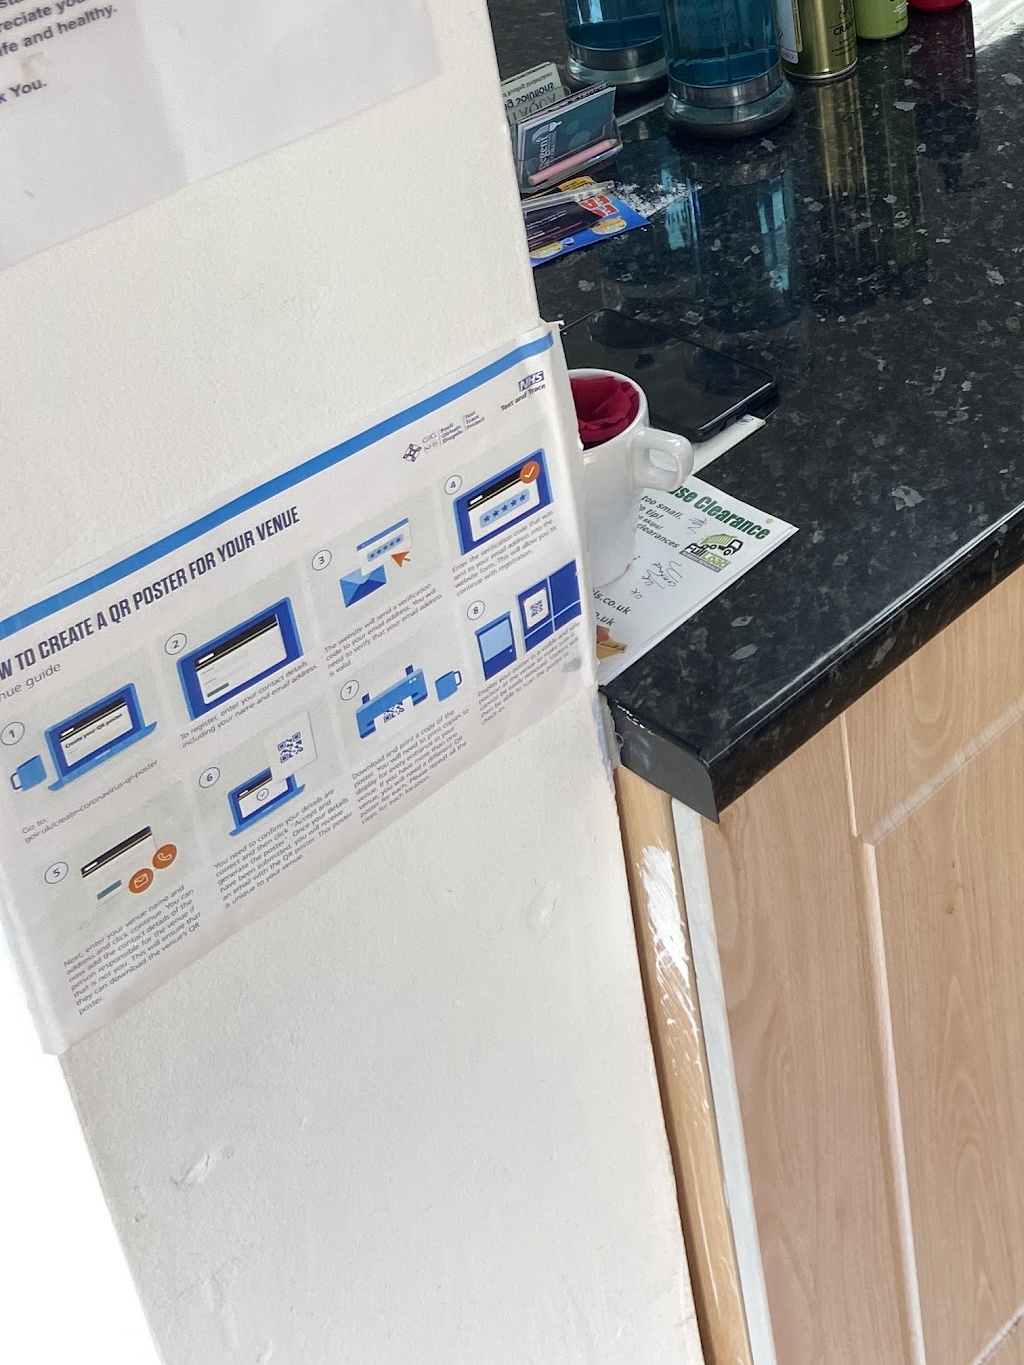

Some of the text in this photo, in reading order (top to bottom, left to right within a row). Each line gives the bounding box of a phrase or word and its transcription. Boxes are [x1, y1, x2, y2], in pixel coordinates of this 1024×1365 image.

[24, 25, 52, 48] and
[58, 5, 117, 35] healthy.
[10, 79, 47, 100] You.
[520, 370, 543, 391] NHS
[501, 382, 546, 412] Test and Trace
[449, 480, 457, 489] 4
[646, 507, 663, 520] tip!
[656, 502, 683, 520] small.
[693, 496, 771, 540] Clearance
[636, 523, 680, 549] clearances
[319, 555, 324, 566] 3
[14, 649, 33, 671] TO
[38, 617, 94, 659] CREATE
[96, 611, 108, 629] A
[109, 598, 131, 624] QR
[133, 568, 187, 609] POSTER
[188, 552, 215, 579] FOR
[218, 531, 254, 562] YOUR
[256, 506, 300, 541] VENUE
[471, 605, 480, 616] 8
[173, 639, 179, 650] 2
[27, 662, 61, 690] guide
[345, 684, 353, 695] 7
[181, 660, 308, 741] To register, enter your contact details
[183, 665, 317, 749] including your name and email address.
[10, 729, 15, 740] 1
[65, 712, 123, 750] Create your QR poster
[207, 772, 213, 783] 6
[54, 867, 60, 878] 5
